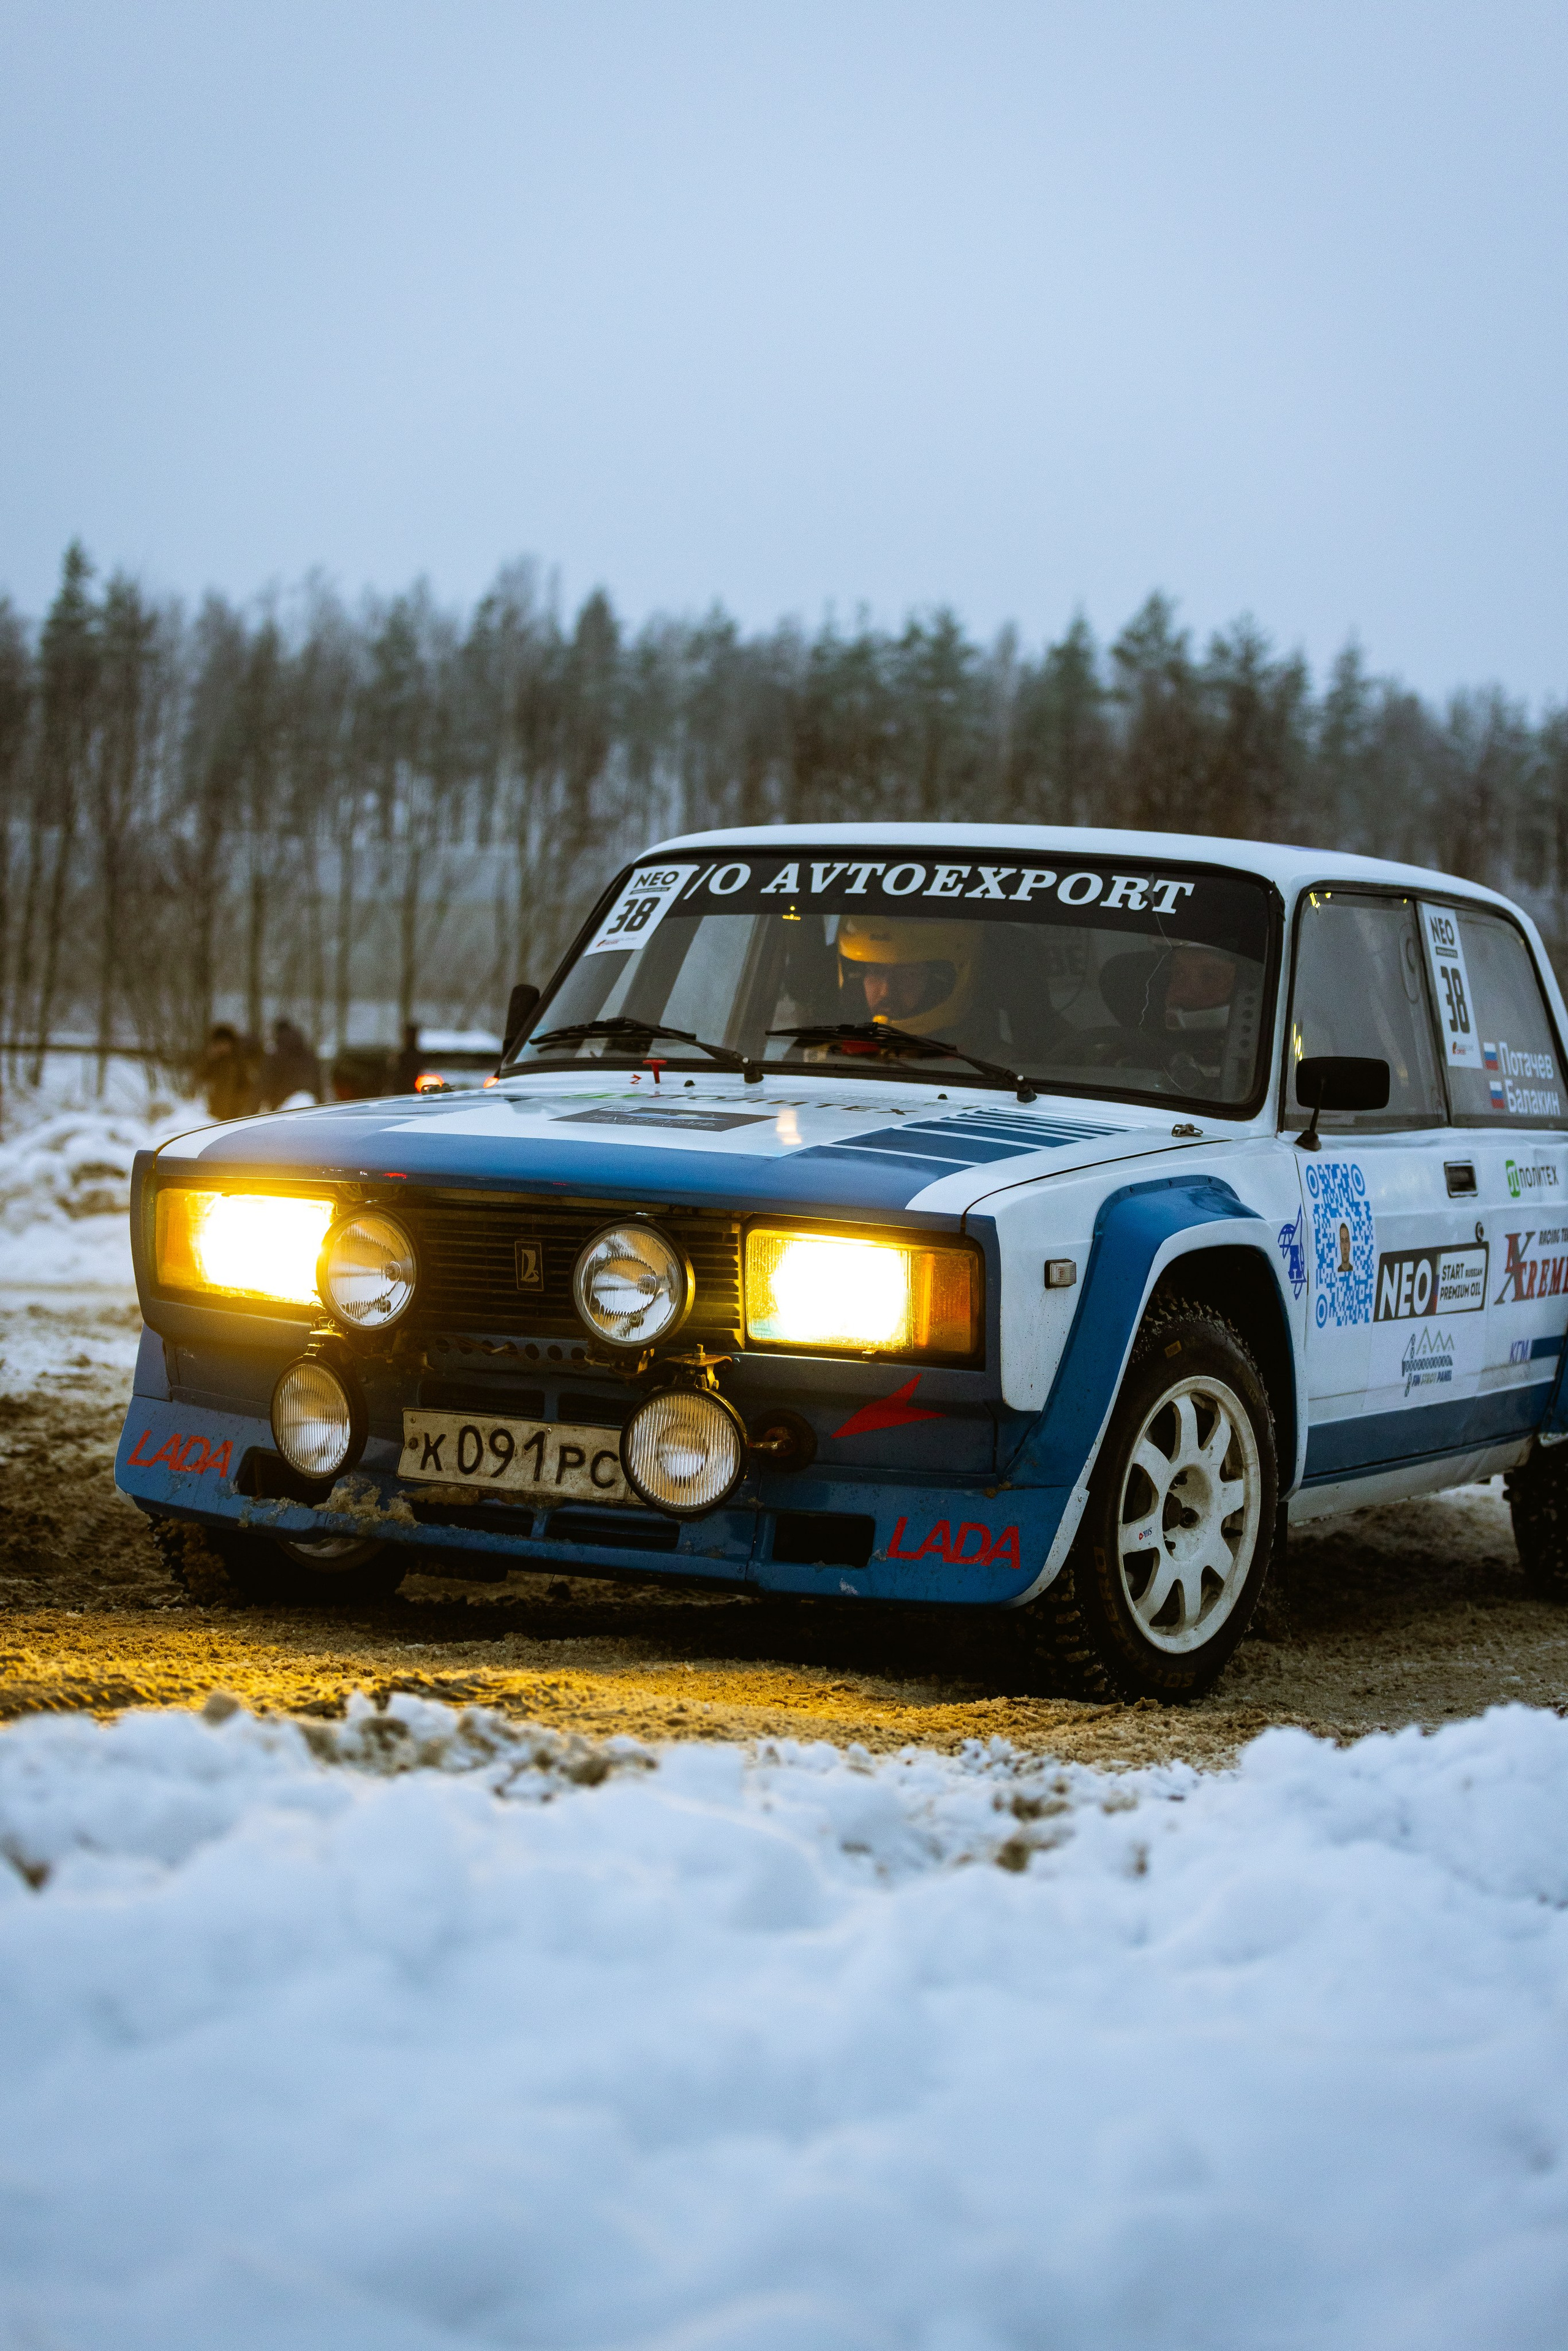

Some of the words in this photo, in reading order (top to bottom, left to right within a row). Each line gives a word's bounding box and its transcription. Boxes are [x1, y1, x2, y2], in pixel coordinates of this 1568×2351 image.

[634, 870, 679, 888] NEO
[760, 862, 1195, 914] AVTOEXPORT
[606, 897, 661, 935] 38
[1430, 916, 1455, 946] NEO
[1440, 965, 1470, 1034] 38
[1499, 1042, 1554, 1079] Потачев
[647, 1094, 920, 1115] ПОЛИТЕХ
[1504, 1079, 1561, 1115] Балакин
[1519, 1166, 1559, 1188] ПОЛИТЕХ
[1379, 1258, 1432, 1319] NEO
[1442, 1263, 1464, 1281] START
[1440, 1284, 1470, 1300] PREMIUM
[1470, 1282, 1481, 1296] OIL
[127, 1430, 233, 1477] LADA
[886, 1516, 1020, 1569] LADA
